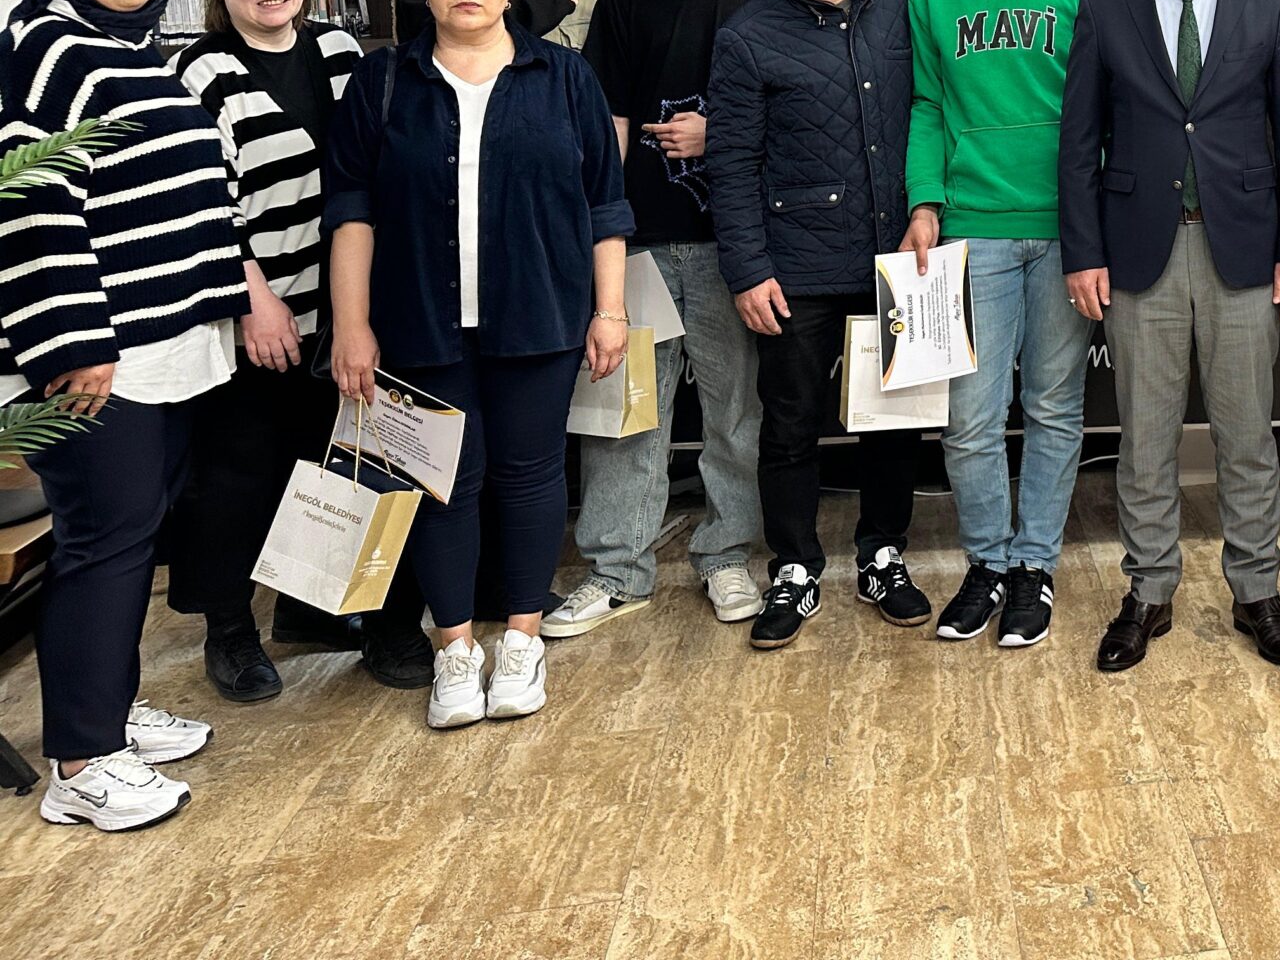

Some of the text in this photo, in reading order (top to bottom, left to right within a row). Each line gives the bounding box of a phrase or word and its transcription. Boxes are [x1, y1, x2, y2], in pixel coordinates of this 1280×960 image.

[955, 5, 1057, 60] MAVİ
[861, 346, 880, 354] İNEG
[294, 488, 362, 525] İNEGÖL BELEDİYESİ
